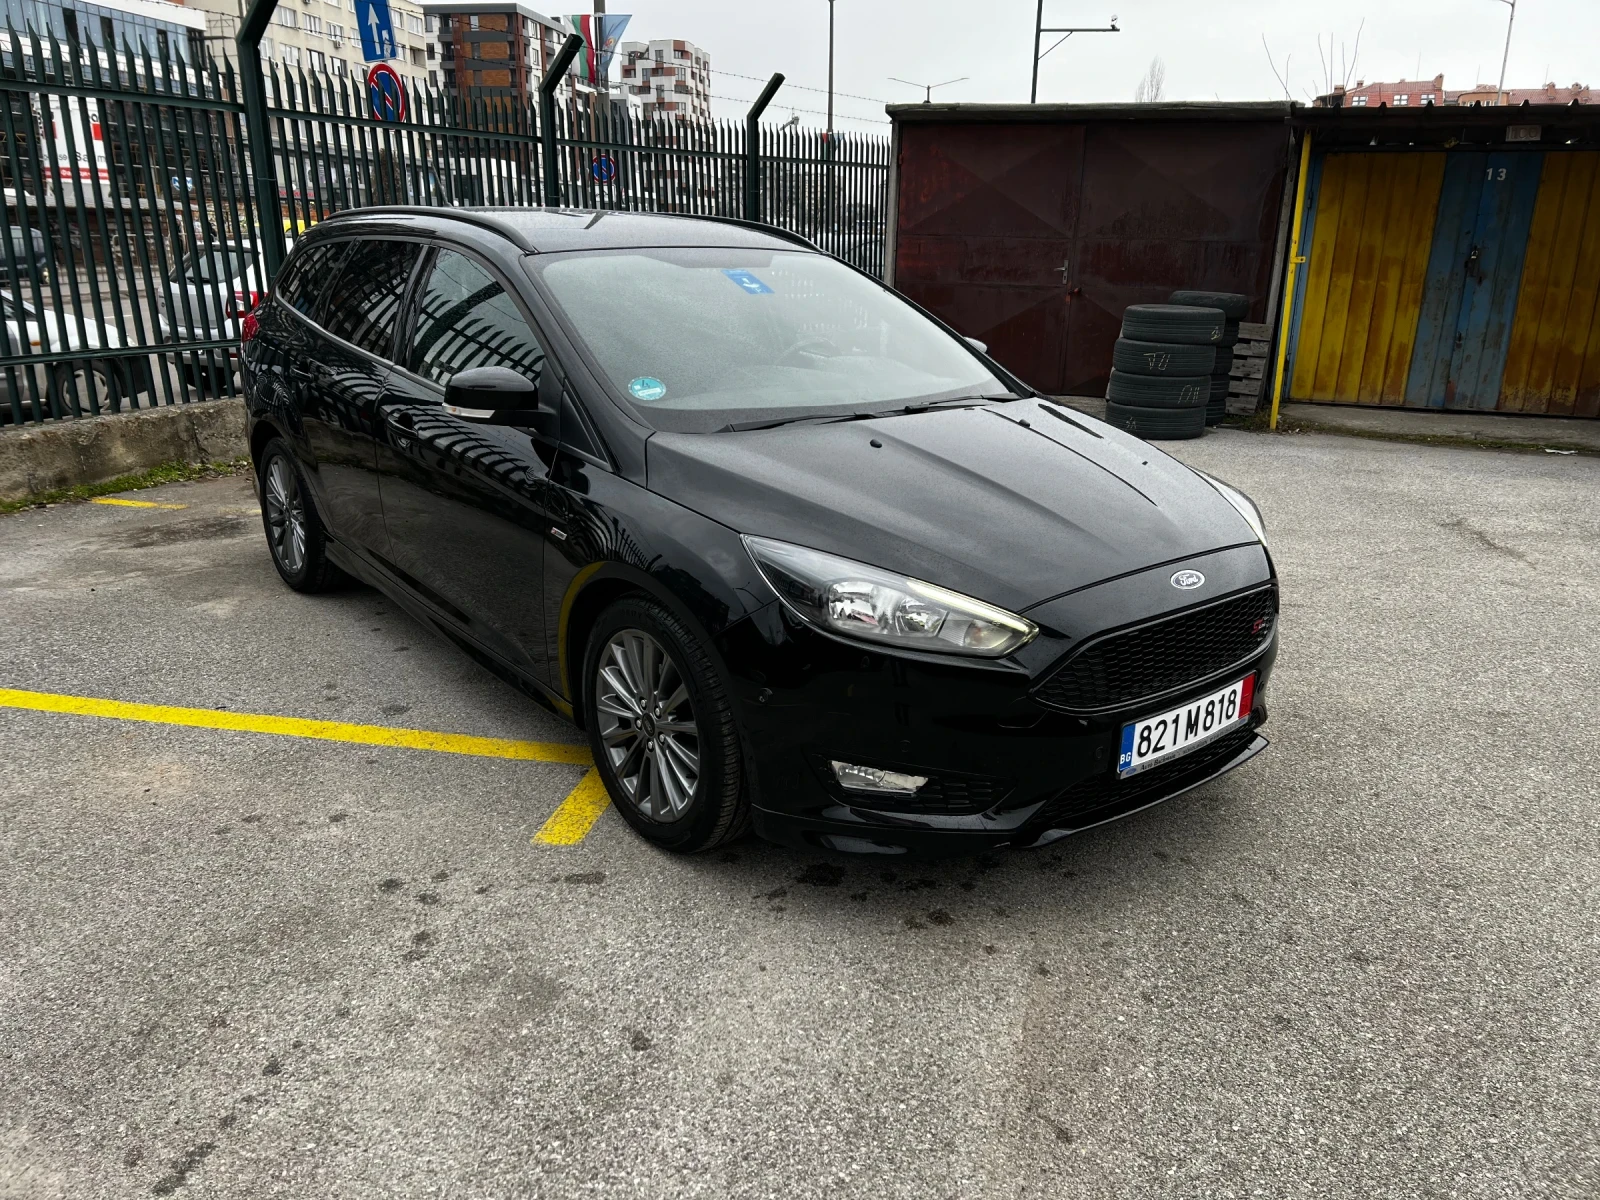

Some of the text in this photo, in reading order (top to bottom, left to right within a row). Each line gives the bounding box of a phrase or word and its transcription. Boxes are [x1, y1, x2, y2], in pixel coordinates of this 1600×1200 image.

[1486, 167, 1507, 181] 13
[1179, 573, 1199, 586] Ford
[1137, 689, 1237, 759] 821M818
[1119, 751, 1132, 765] BG
